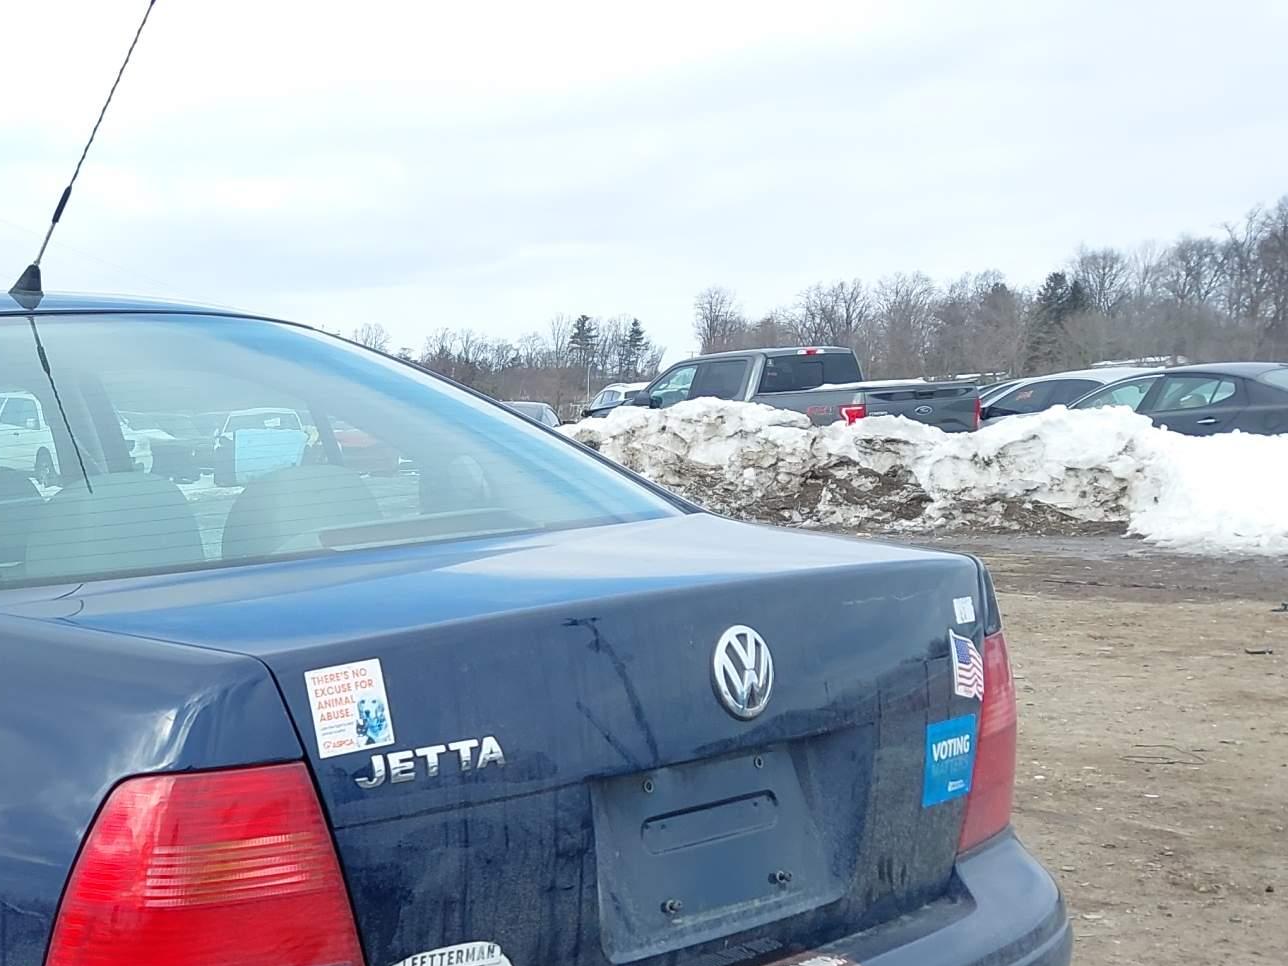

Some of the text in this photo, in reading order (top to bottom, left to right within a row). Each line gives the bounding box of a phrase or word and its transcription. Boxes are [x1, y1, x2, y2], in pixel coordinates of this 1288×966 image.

[311, 667, 367, 686] THERE'S NO
[314, 679, 374, 698] EXCUSE FOR
[317, 695, 356, 710] ANIMAL
[320, 708, 354, 722] ABUSE.
[932, 734, 970, 762] VOTING
[354, 736, 506, 789] JETTA
